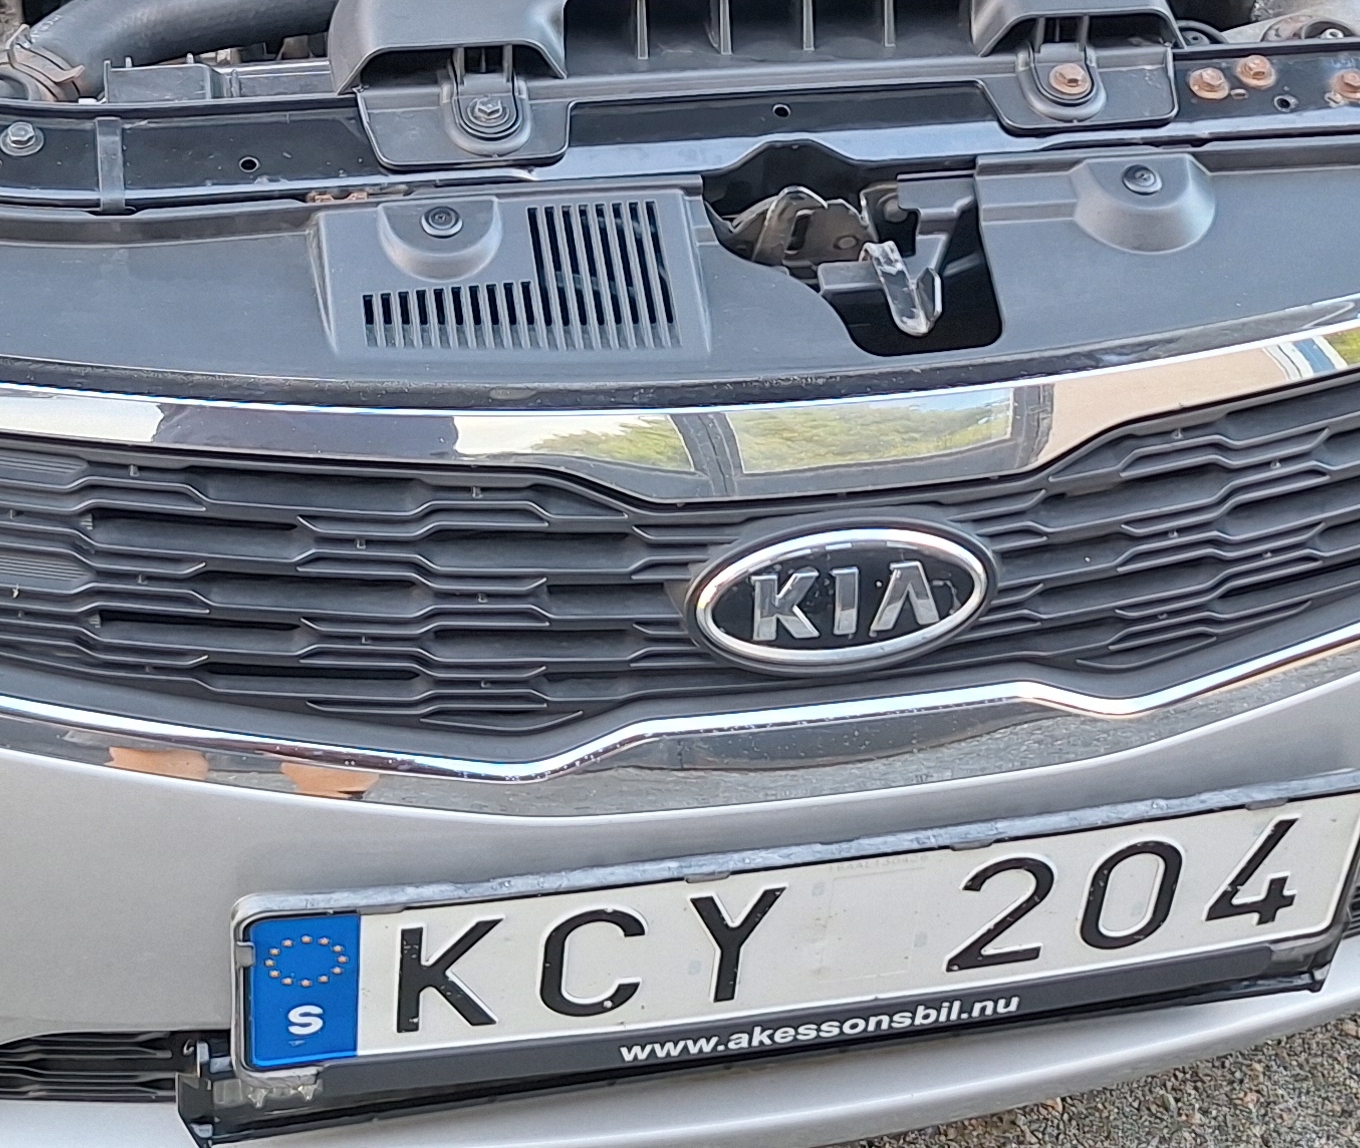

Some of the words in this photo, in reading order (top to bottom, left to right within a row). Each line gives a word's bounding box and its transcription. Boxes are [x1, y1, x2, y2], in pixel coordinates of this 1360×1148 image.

[750, 560, 940, 641] KIA
[396, 886, 787, 1033] KCY
[945, 816, 1300, 973] 204
[287, 1004, 324, 1035] S
[620, 995, 1020, 1062] www.akessonsbil.nu
